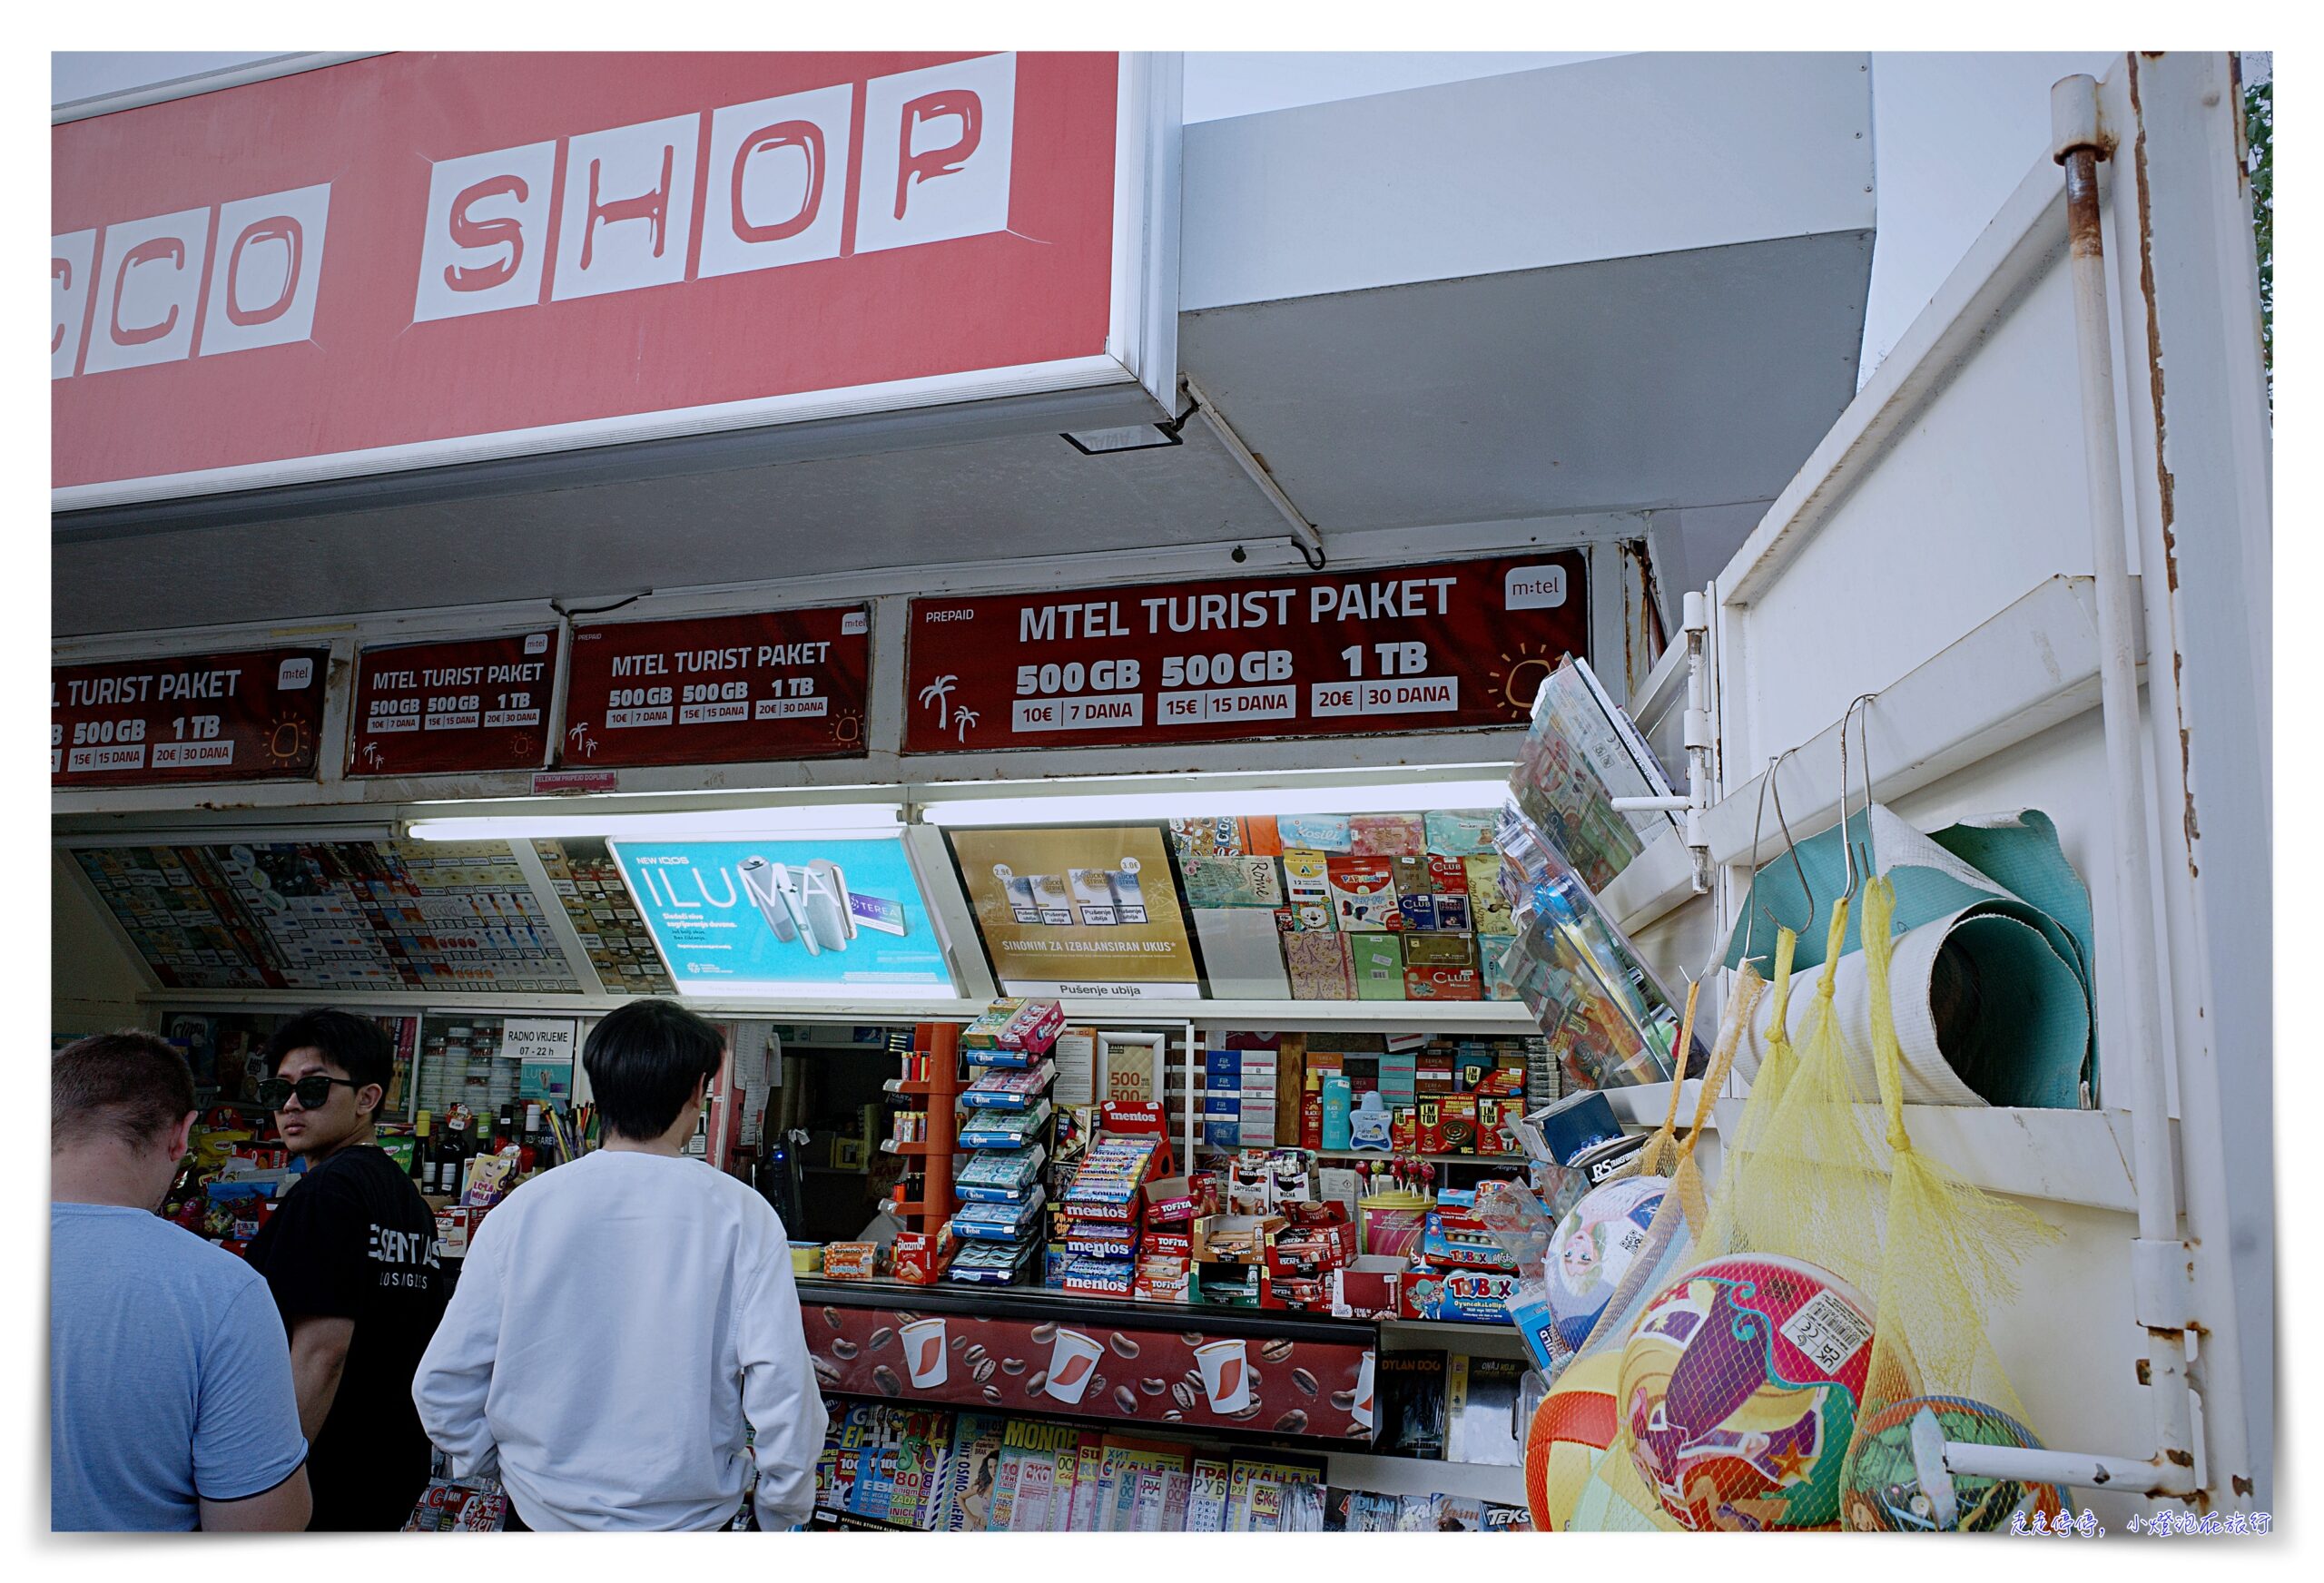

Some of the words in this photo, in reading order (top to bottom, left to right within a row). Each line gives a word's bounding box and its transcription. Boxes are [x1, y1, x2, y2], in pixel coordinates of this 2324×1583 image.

[52, 217, 302, 354] CO
[444, 89, 982, 293] SHOP
[1513, 576, 1560, 596] m:tel
[925, 608, 975, 623] PREPAID
[1019, 601, 1130, 643] MTEL
[1140, 588, 1296, 634] TURIST
[1310, 576, 1457, 624] PAKET
[612, 654, 669, 677] MTEL
[674, 646, 753, 673] TURIST
[757, 641, 831, 667] PAKET
[1341, 644, 1363, 677] 1
[1374, 641, 1429, 676] TB
[281, 667, 310, 681] m:tel
[372, 671, 418, 690] MTEL
[422, 666, 484, 687] TURIST
[487, 663, 545, 683] PAKET
[67, 675, 153, 706] TURIST
[158, 669, 241, 701] PAKET
[788, 676, 814, 697] TB
[1022, 706, 1053, 723] 10€
[1071, 705, 1079, 720] 7
[1085, 702, 1133, 720] DANA
[1166, 698, 1197, 715] 15€
[1212, 696, 1232, 713] 15
[1238, 693, 1288, 713] DANA
[1318, 690, 1354, 707] 20€
[1368, 688, 1393, 704] 30
[1398, 684, 1451, 703] DANA
[456, 714, 477, 725] DANA
[517, 712, 537, 723] DANA
[611, 713, 627, 723] 10€
[644, 710, 668, 722] DANA
[684, 709, 700, 719] 15€
[707, 707, 717, 718] 15
[719, 705, 744, 717] DANA
[759, 703, 777, 714] 20€
[783, 703, 795, 713] 30
[797, 702, 823, 713] DANA
[191, 714, 221, 739] TB
[74, 753, 91, 765] 15€
[98, 752, 109, 763] 15
[112, 750, 141, 763] DANA
[156, 749, 177, 761] 20€
[183, 747, 197, 760] 30
[199, 745, 229, 759] DANA
[635, 856, 657, 865] NEW
[1432, 861, 1462, 871] CLUB
[641, 863, 842, 908] ILUMA
[860, 901, 899, 917] TEREA
[1403, 900, 1431, 909] CLUB
[1001, 940, 1047, 951] SINONIM
[1050, 941, 1062, 951] ZA
[1065, 941, 1140, 952] IZBALANSIRAN
[1059, 985, 1108, 996] Pušenje
[1111, 985, 1141, 997] ubija
[507, 1030, 535, 1042] RADNO
[536, 1031, 568, 1043] VRIJEME
[519, 1047, 529, 1056] 07
[537, 1047, 547, 1057] 22
[548, 1047, 554, 1057] h
[1109, 1072, 1141, 1087] 500
[1110, 1111, 1157, 1123] mentos
[1423, 1105, 1435, 1114] LM
[1483, 1106, 1494, 1115] LM
[1422, 1115, 1436, 1124] TOX
[1483, 1115, 1496, 1124] TOX
[1591, 1158, 1614, 1179] RS
[1234, 1185, 1262, 1194] CAPPUCCINO
[1066, 1204, 1128, 1219] mentos
[1067, 1240, 1129, 1255] mentos
[1066, 1277, 1128, 1293] mentos
[1381, 1359, 1415, 1372] DYLAN
[1416, 1359, 1441, 1372] DOG
[895, 1471, 918, 1487] 80
[1487, 1509, 1531, 1525] TEKS
